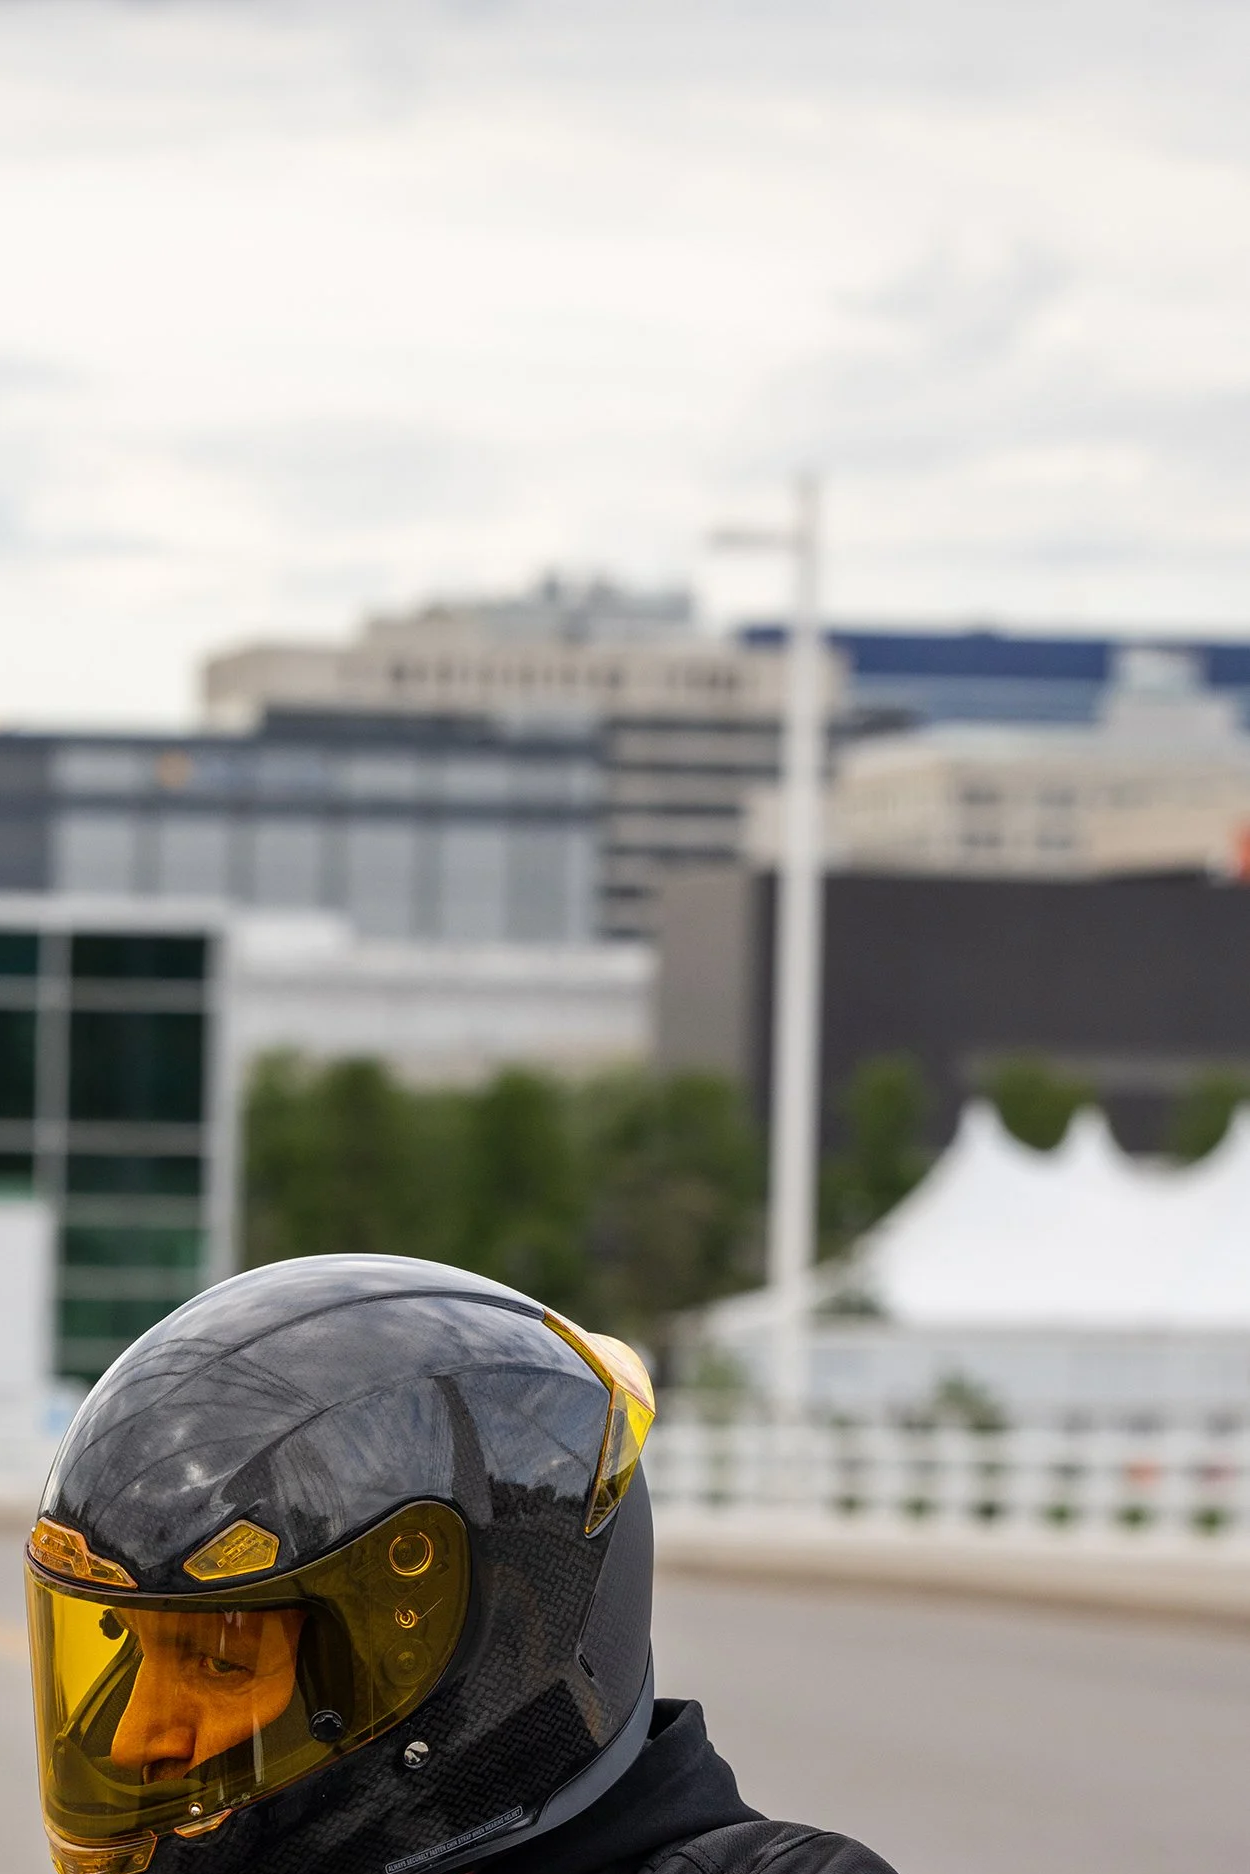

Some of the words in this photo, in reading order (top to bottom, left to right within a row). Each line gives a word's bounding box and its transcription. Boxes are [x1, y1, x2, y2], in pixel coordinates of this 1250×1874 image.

[388, 1861, 406, 1872] ALWAYS
[406, 1852, 429, 1866] SECURELY
[446, 1840, 457, 1850] CHIN
[458, 1833, 471, 1844] STRAP
